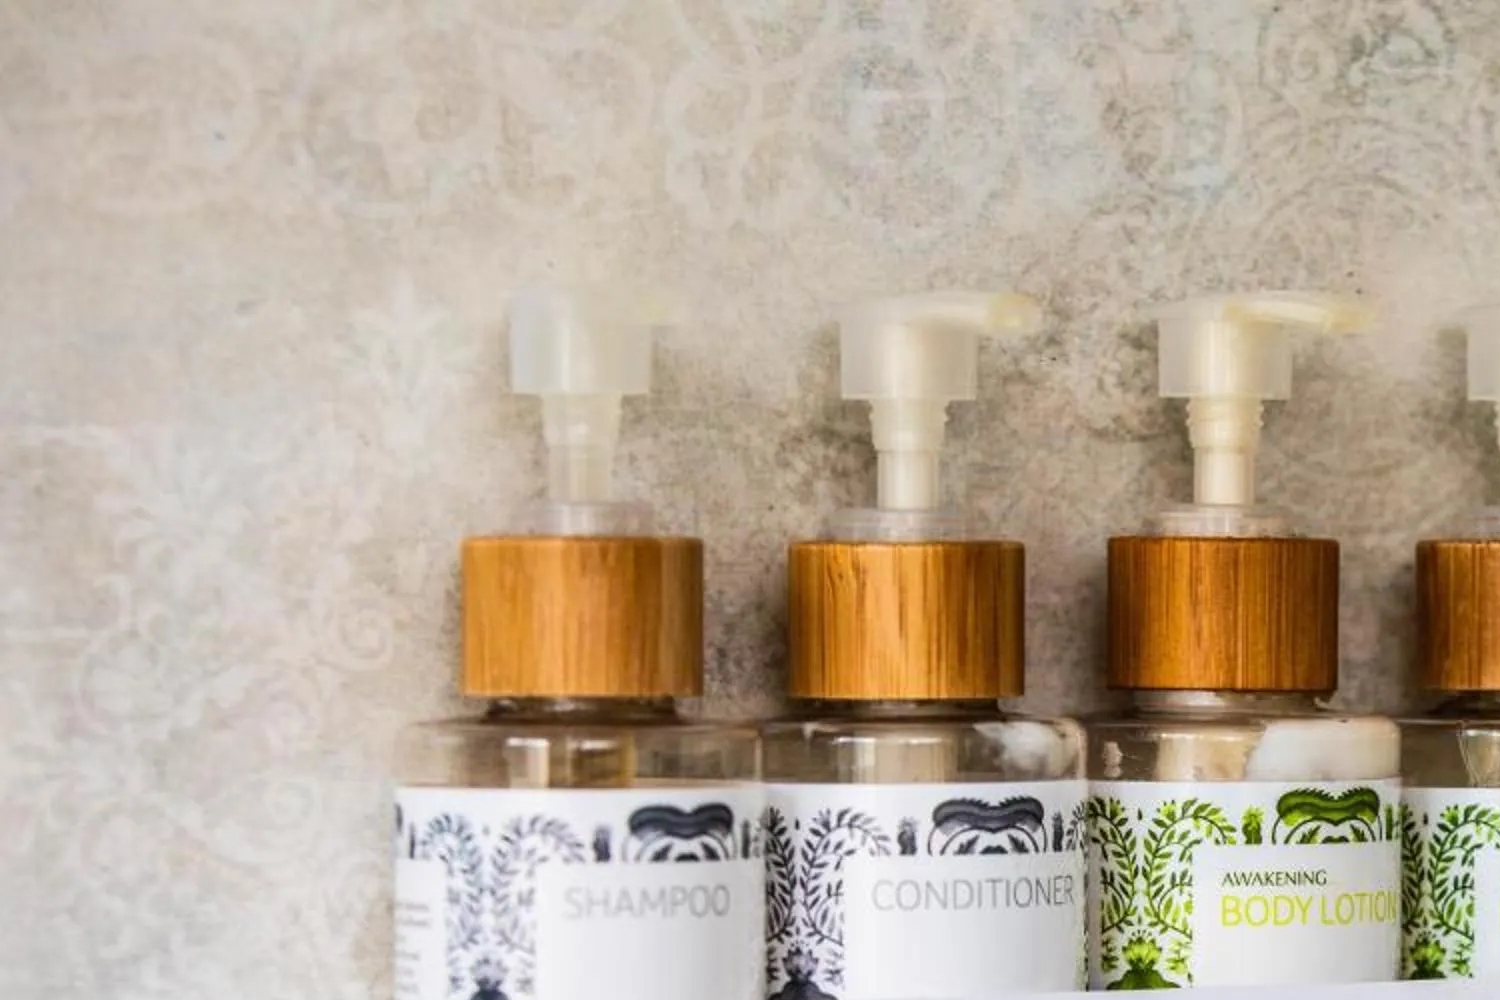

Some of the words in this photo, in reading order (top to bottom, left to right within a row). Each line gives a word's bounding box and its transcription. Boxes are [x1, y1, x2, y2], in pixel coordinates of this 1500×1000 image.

[871, 874, 1075, 911] CONDITIONER
[1221, 868, 1327, 887] AWAKENING
[563, 883, 731, 919] SHAMPOO
[1220, 894, 1314, 927] BODY
[1319, 889, 1396, 927] LOTION
